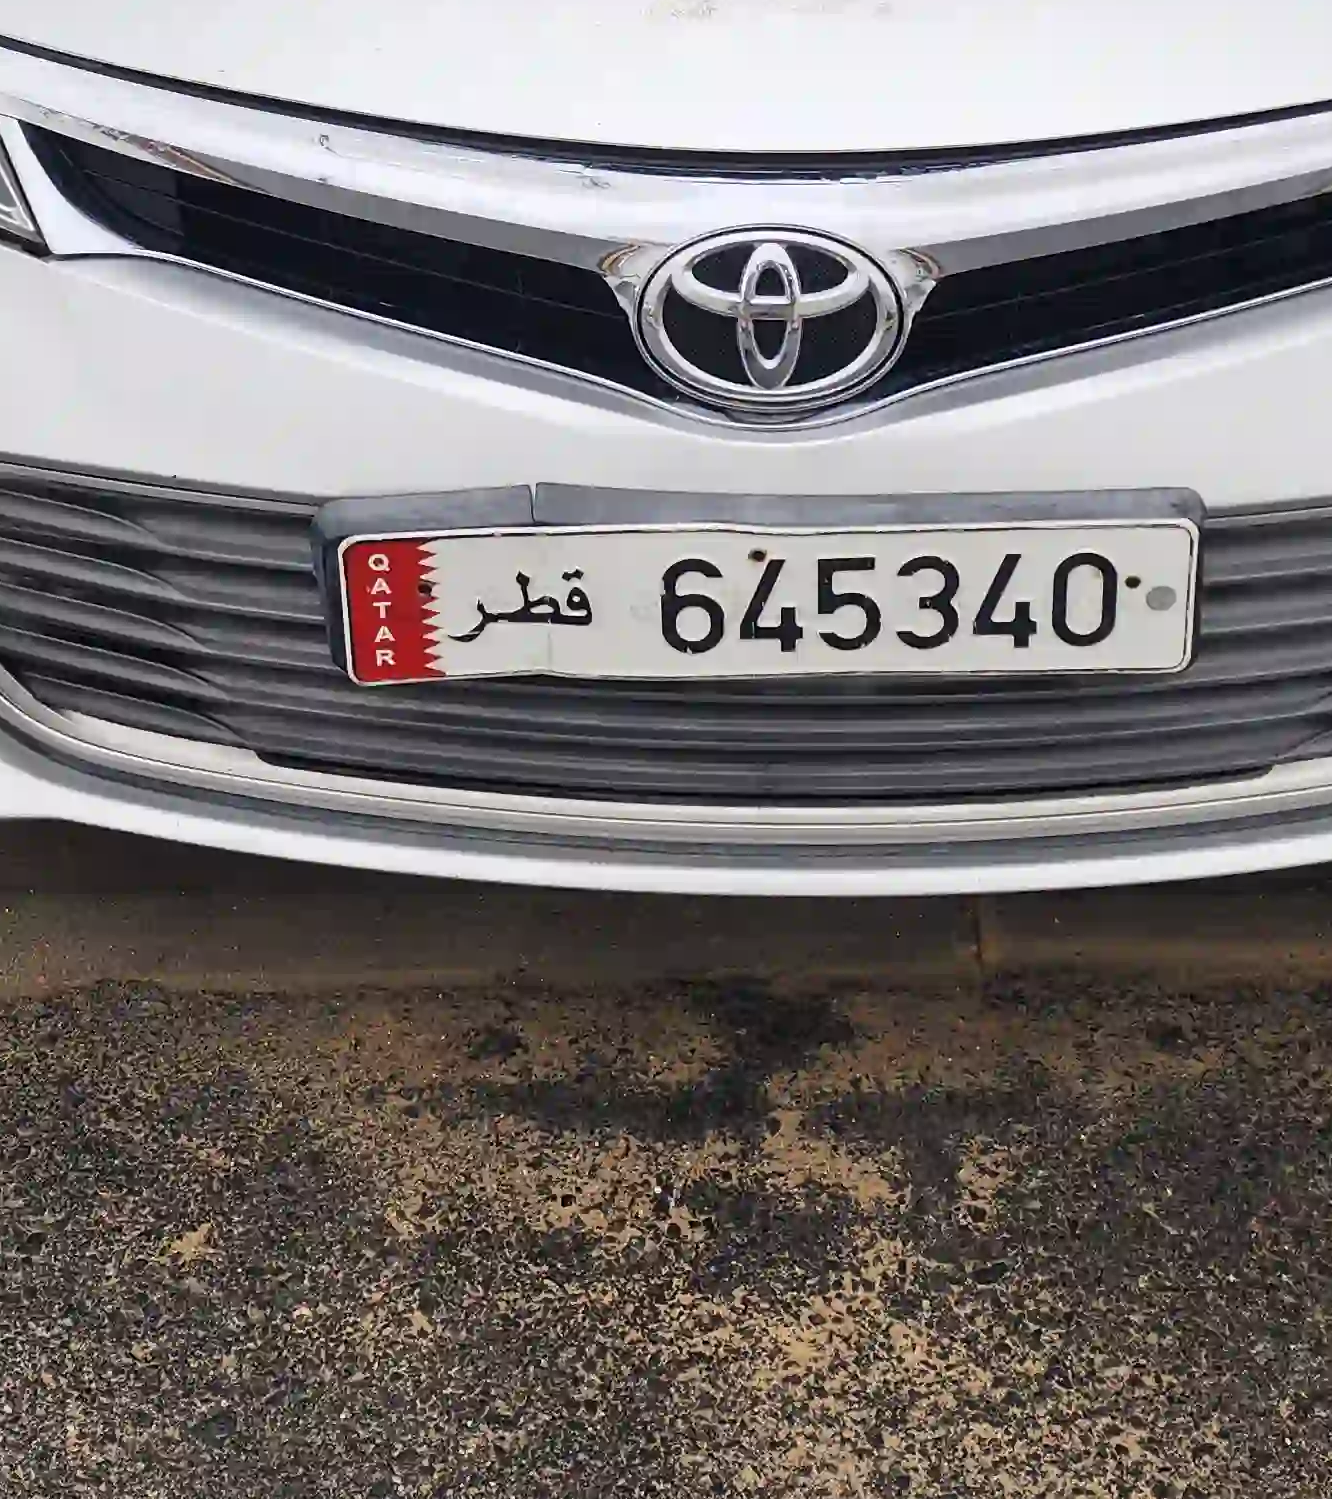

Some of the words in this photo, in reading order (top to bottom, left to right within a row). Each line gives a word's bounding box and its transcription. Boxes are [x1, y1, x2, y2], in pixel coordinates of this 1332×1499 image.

[368, 553, 396, 667] QATAR
[447, 566, 593, 643] قطر
[660, 552, 1119, 654] 645340
